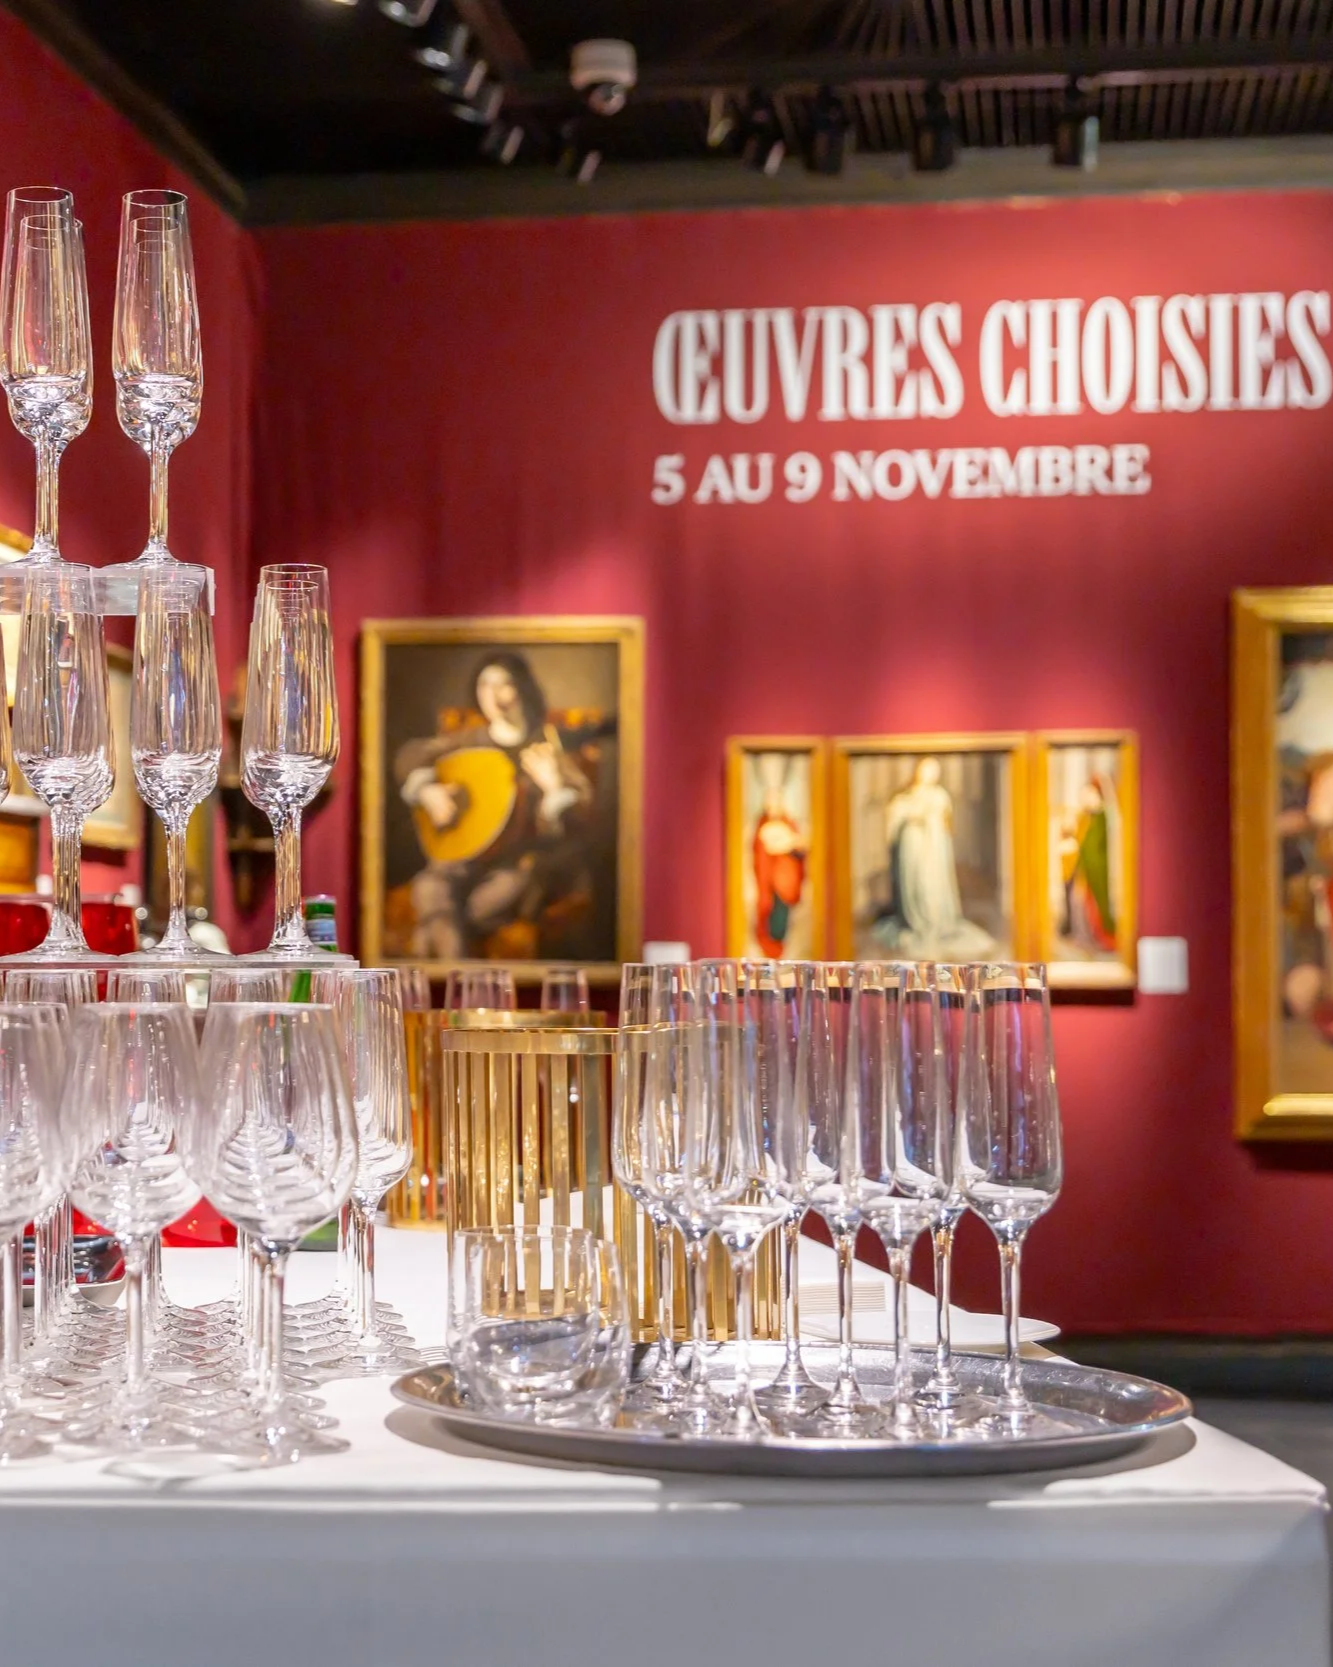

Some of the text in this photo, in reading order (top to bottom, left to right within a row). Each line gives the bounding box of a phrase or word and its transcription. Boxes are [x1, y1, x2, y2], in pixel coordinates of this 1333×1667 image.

[653, 291, 1332, 423] ŒUVRES CHOISIES
[652, 443, 1151, 504] 5 AU 9 NOVEMBRE
